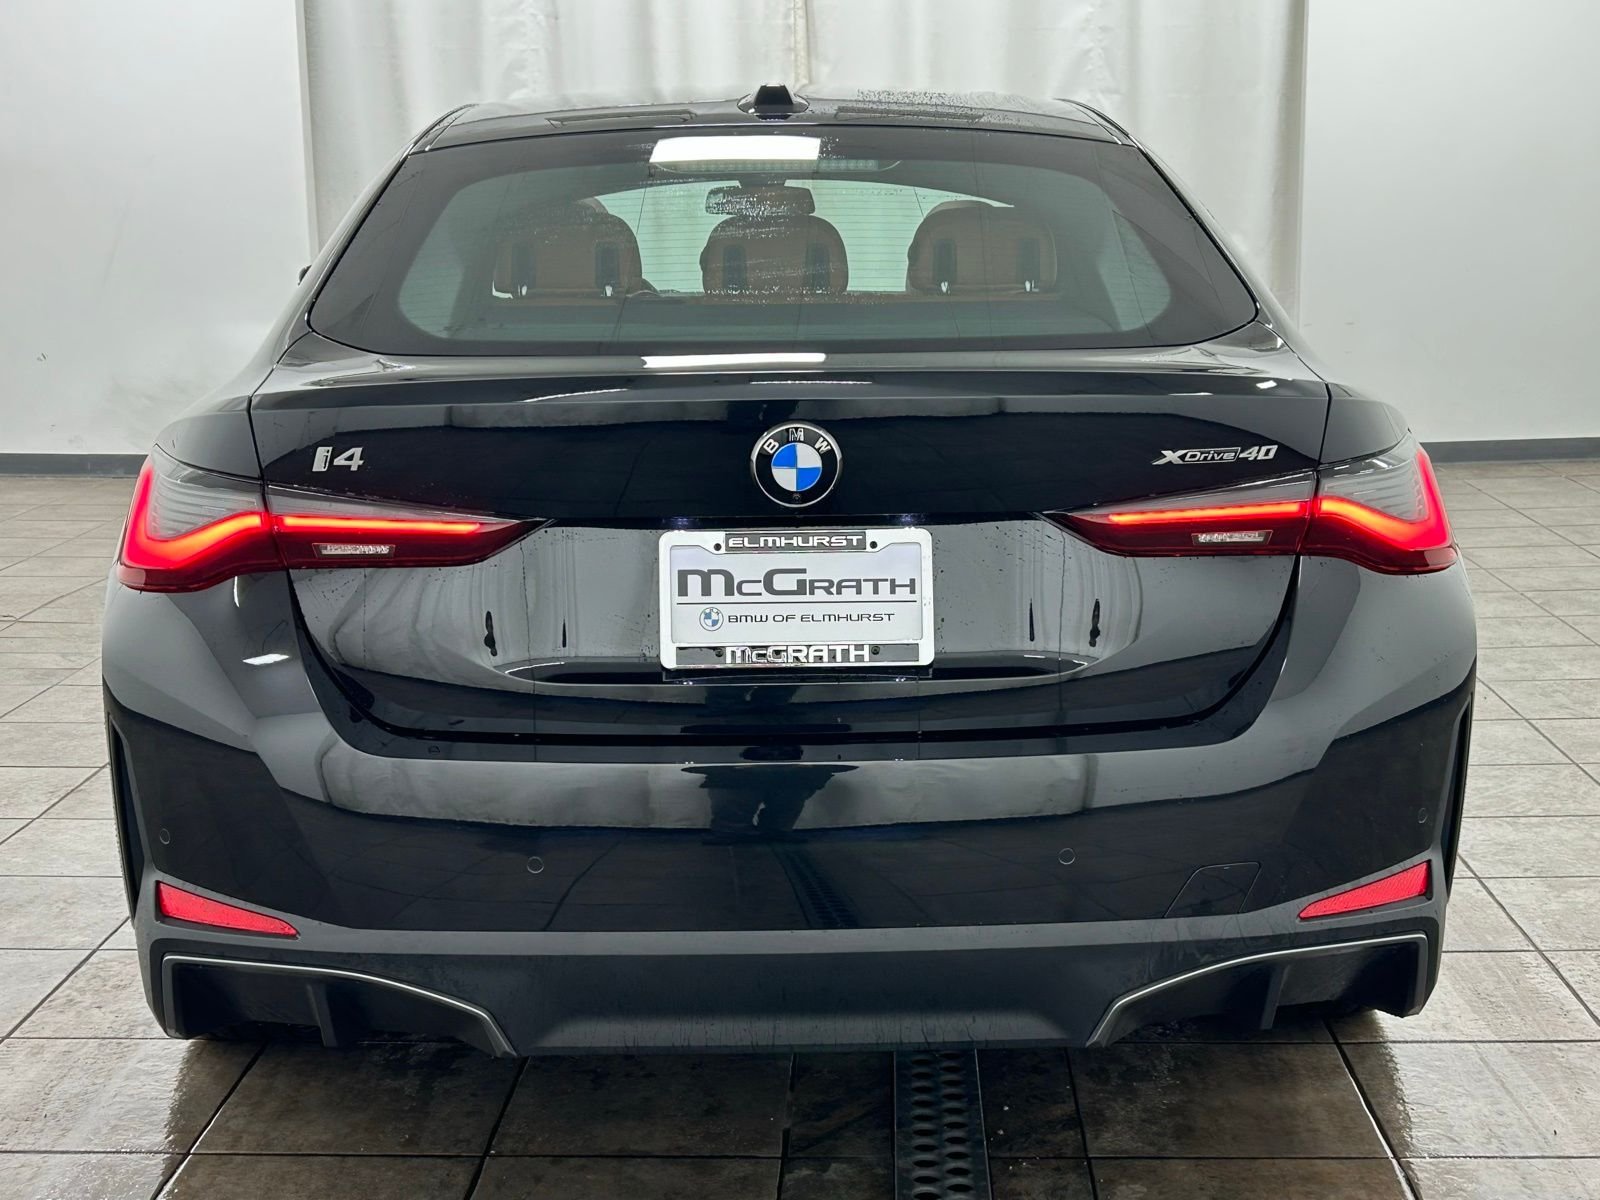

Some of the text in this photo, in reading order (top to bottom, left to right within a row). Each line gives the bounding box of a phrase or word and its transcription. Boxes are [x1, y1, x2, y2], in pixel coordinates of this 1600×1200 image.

[763, 428, 831, 455] BMW
[312, 446, 364, 471] i4
[728, 535, 863, 547] ELMHURST
[728, 613, 895, 623] BMW OF ELMHURST
